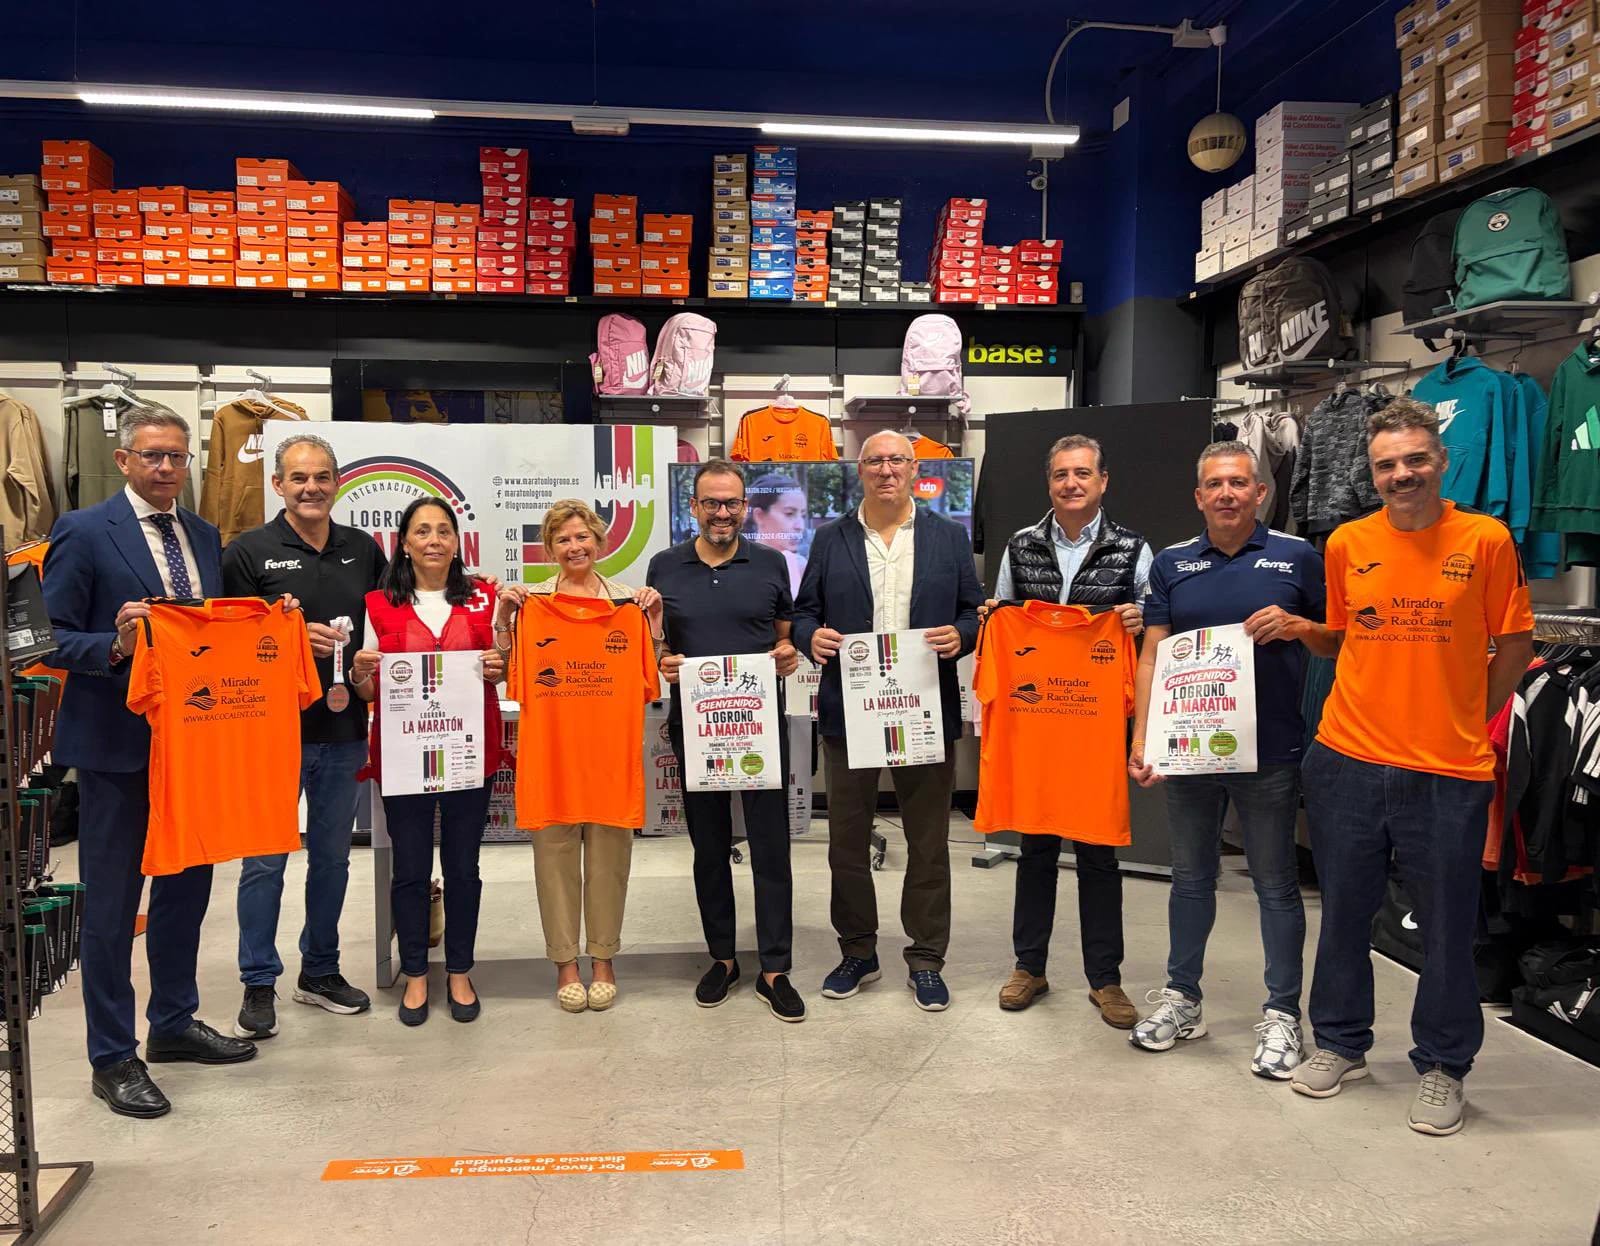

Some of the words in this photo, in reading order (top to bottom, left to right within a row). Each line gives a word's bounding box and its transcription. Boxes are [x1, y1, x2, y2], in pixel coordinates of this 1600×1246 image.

[1281, 300, 1330, 351] NIKE
[346, 482, 425, 503] INTERNACIONA
[919, 481, 937, 494] tdp
[350, 510, 404, 527] LOGRO
[505, 528, 518, 541] 42K
[505, 548, 518, 562] 21K
[265, 559, 301, 570] Ferrer
[1177, 560, 1212, 572] Sapje
[1254, 558, 1294, 569] Ferrer
[506, 569, 518, 582] 10K
[1391, 598, 1445, 609] Mirador
[1411, 609, 1423, 617] de
[1391, 616, 1419, 626] Raco
[1420, 617, 1452, 627] Calent
[565, 661, 607, 670] Mirador
[220, 677, 260, 687] Mirador
[565, 676, 587, 684] Raco
[587, 675, 613, 684] Calent
[1047, 677, 1091, 688] Mirador
[1167, 670, 1235, 686] BIENVENIDOS
[1172, 682, 1226, 700] LOGROÑO
[220, 695, 241, 705] Raco
[242, 694, 266, 704] Calent
[863, 698, 876, 711] LA
[877, 693, 921, 710] MARATÓN
[1046, 693, 1070, 702] Raco
[1070, 693, 1098, 703] Calent
[699, 698, 761, 711] BIENVENIDOS
[1162, 700, 1182, 716] LA
[1181, 694, 1237, 713] MARATÓN
[705, 708, 754, 724] LOGROÑO
[1008, 705, 1098, 717] WWW.RACOCALENT.COM
[402, 720, 415, 734] LA
[417, 715, 463, 733] MARATÓN
[698, 724, 713, 737] LA
[714, 720, 763, 736] MARATÓN
[655, 778, 669, 789] LA
[454, 1157, 532, 1167] seguridad
[559, 1155, 626, 1163] distancia
[450, 1167, 464, 1175] la
[468, 1165, 545, 1176] mantenga
[599, 1163, 625, 1171] Por
